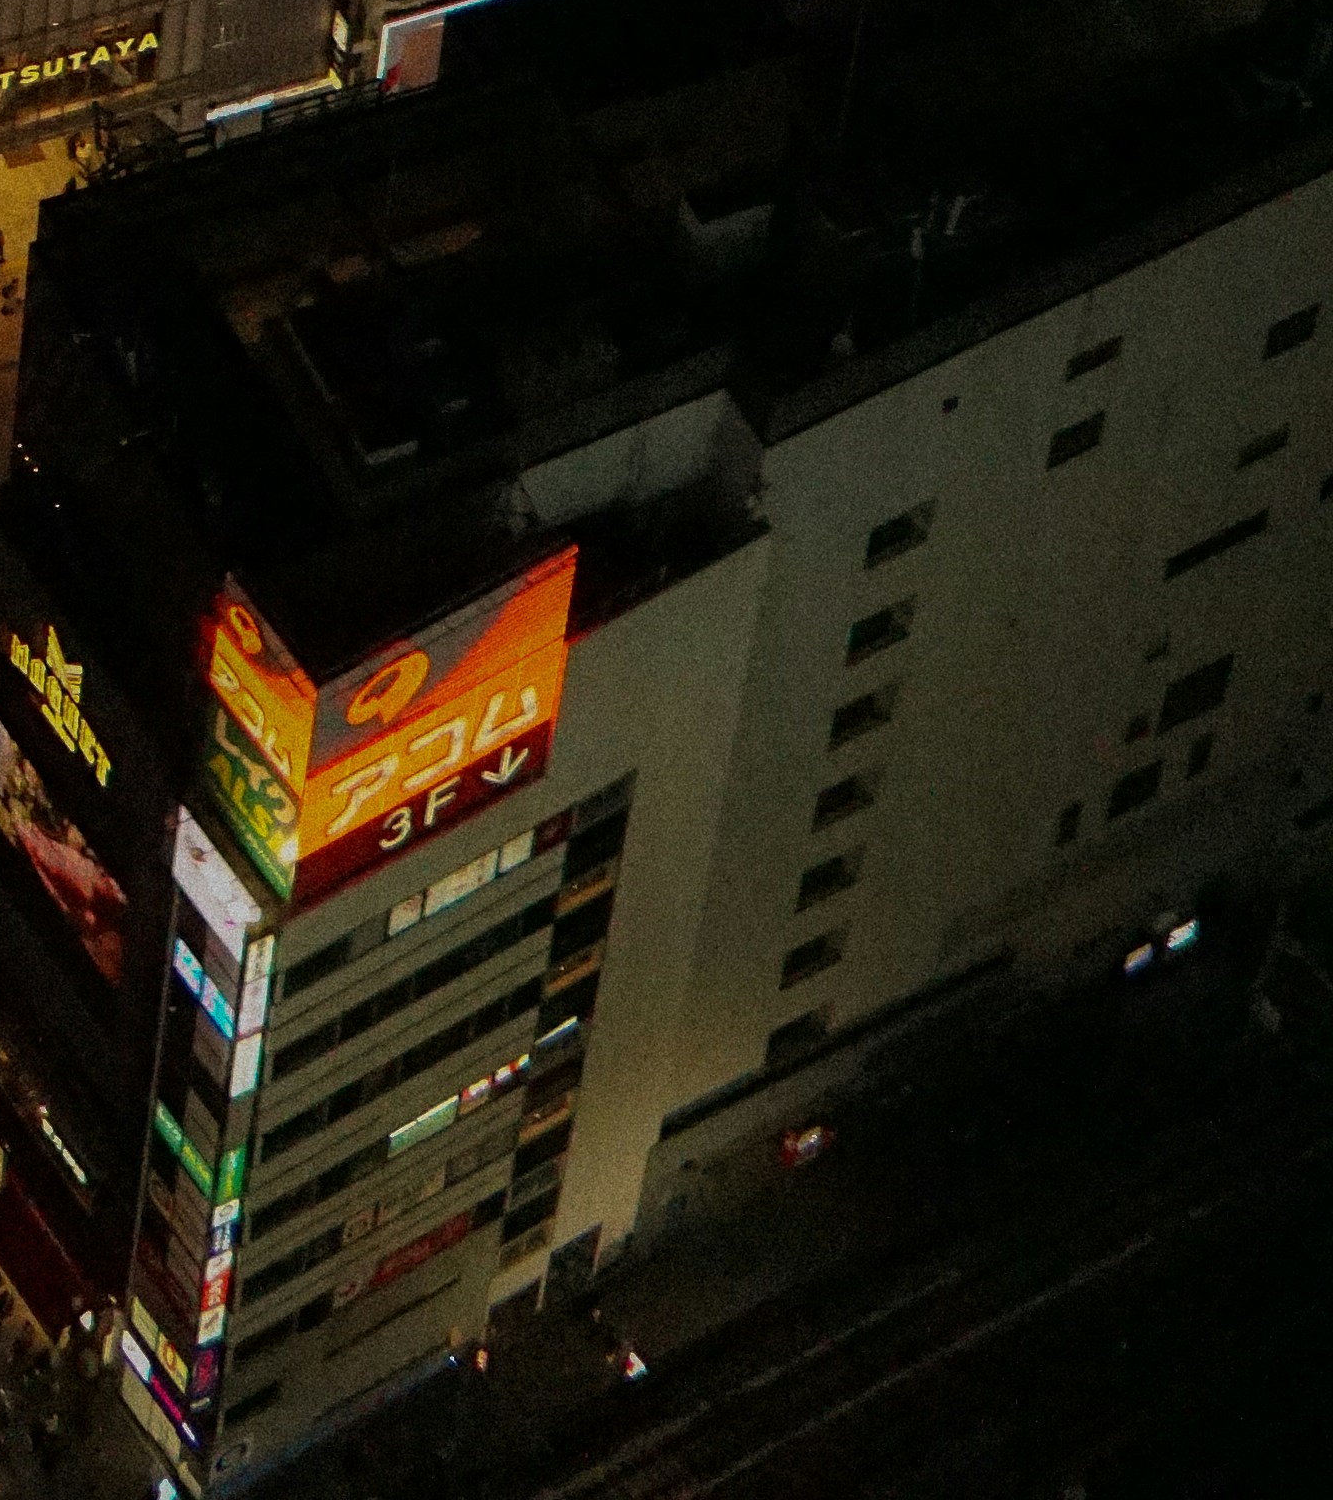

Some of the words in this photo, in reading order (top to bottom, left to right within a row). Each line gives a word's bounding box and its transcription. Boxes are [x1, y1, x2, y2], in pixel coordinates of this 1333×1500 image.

[0, 33, 159, 90] TSUTAYA
[209, 650, 292, 778] アコム
[326, 687, 538, 837] アコム
[378, 779, 461, 851] 3F
